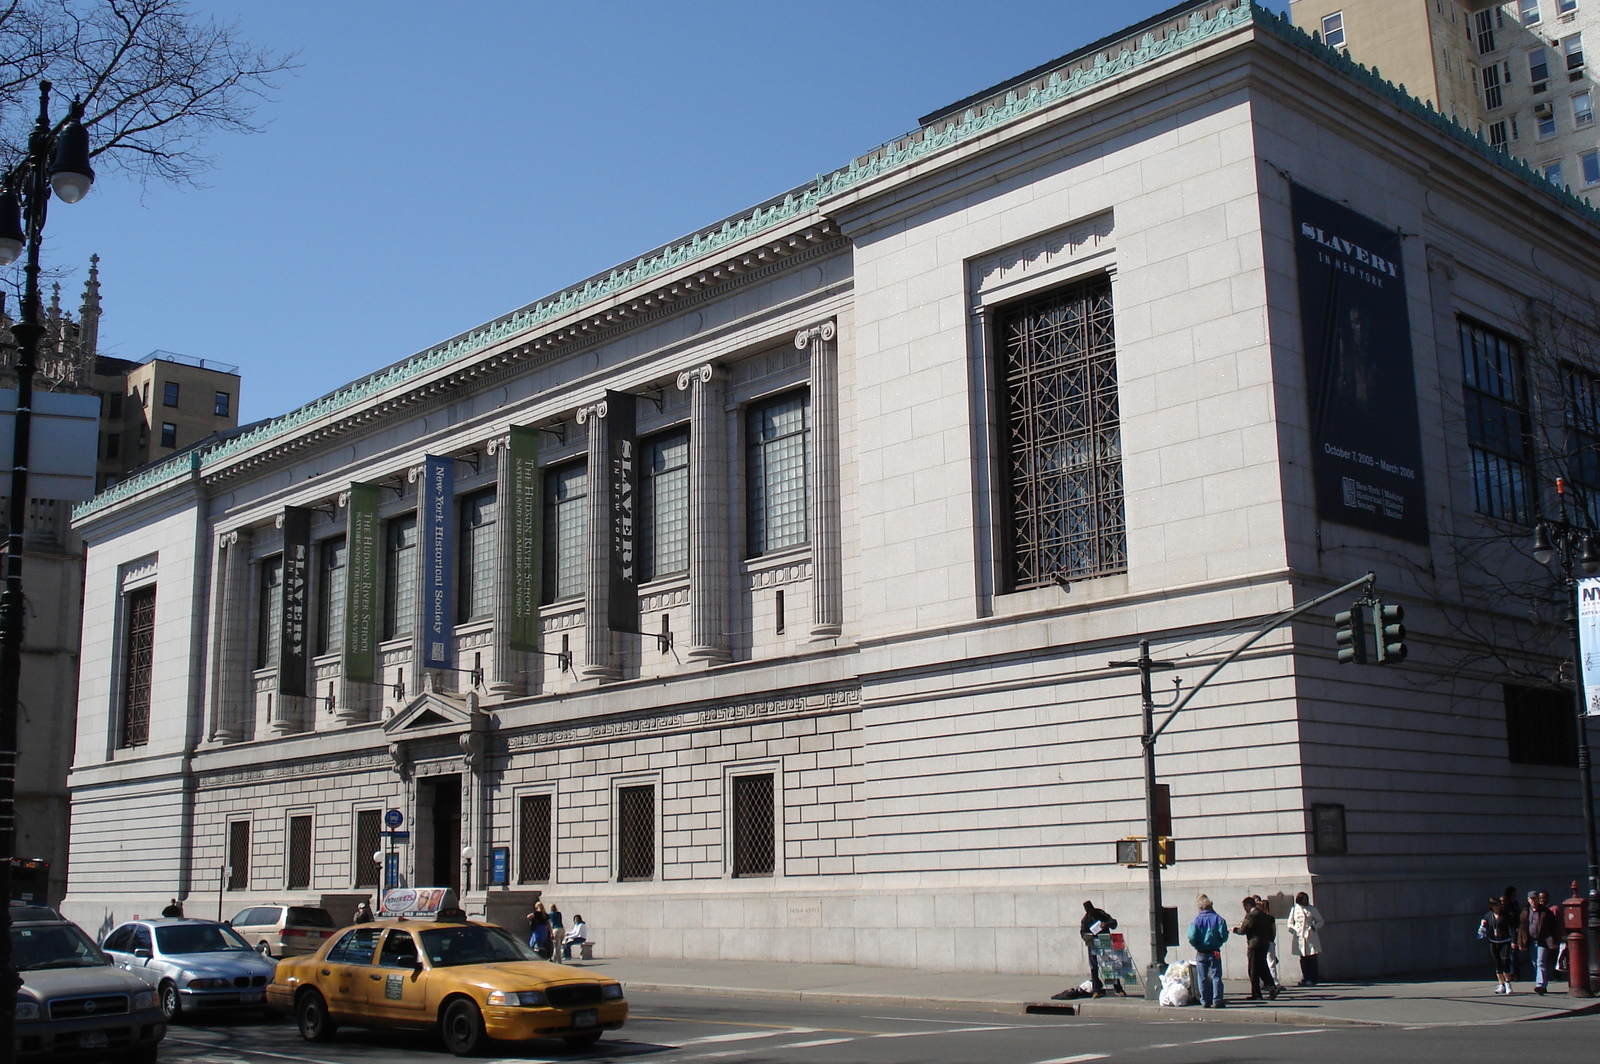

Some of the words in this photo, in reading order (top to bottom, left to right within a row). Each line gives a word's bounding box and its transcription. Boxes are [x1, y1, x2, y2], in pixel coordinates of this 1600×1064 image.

[1302, 222, 1398, 278] SLAVERY
[1319, 252, 1331, 265] IN
[1335, 259, 1356, 276] NEW
[1360, 270, 1383, 288] YORK
[524, 459, 534, 482] THE
[614, 459, 620, 475] IN
[1324, 443, 1351, 459] October
[1358, 452, 1374, 466] 2005
[1380, 460, 1399, 475] March
[1400, 466, 1415, 480] 2006
[435, 466, 445, 524] New-York
[524, 486, 534, 533] HUDSON
[621, 440, 633, 583] SLAVERY
[364, 512, 373, 533] THE
[288, 560, 292, 572] IN
[362, 537, 373, 579] HUDSON
[434, 526, 444, 587] Historical
[524, 537, 533, 570] RIVER
[292, 545, 306, 657] SLAVERY
[362, 582, 372, 610] RIVER
[432, 589, 444, 635] Society
[524, 572, 533, 617] SCHOOL
[360, 614, 371, 654] SCHOOL
